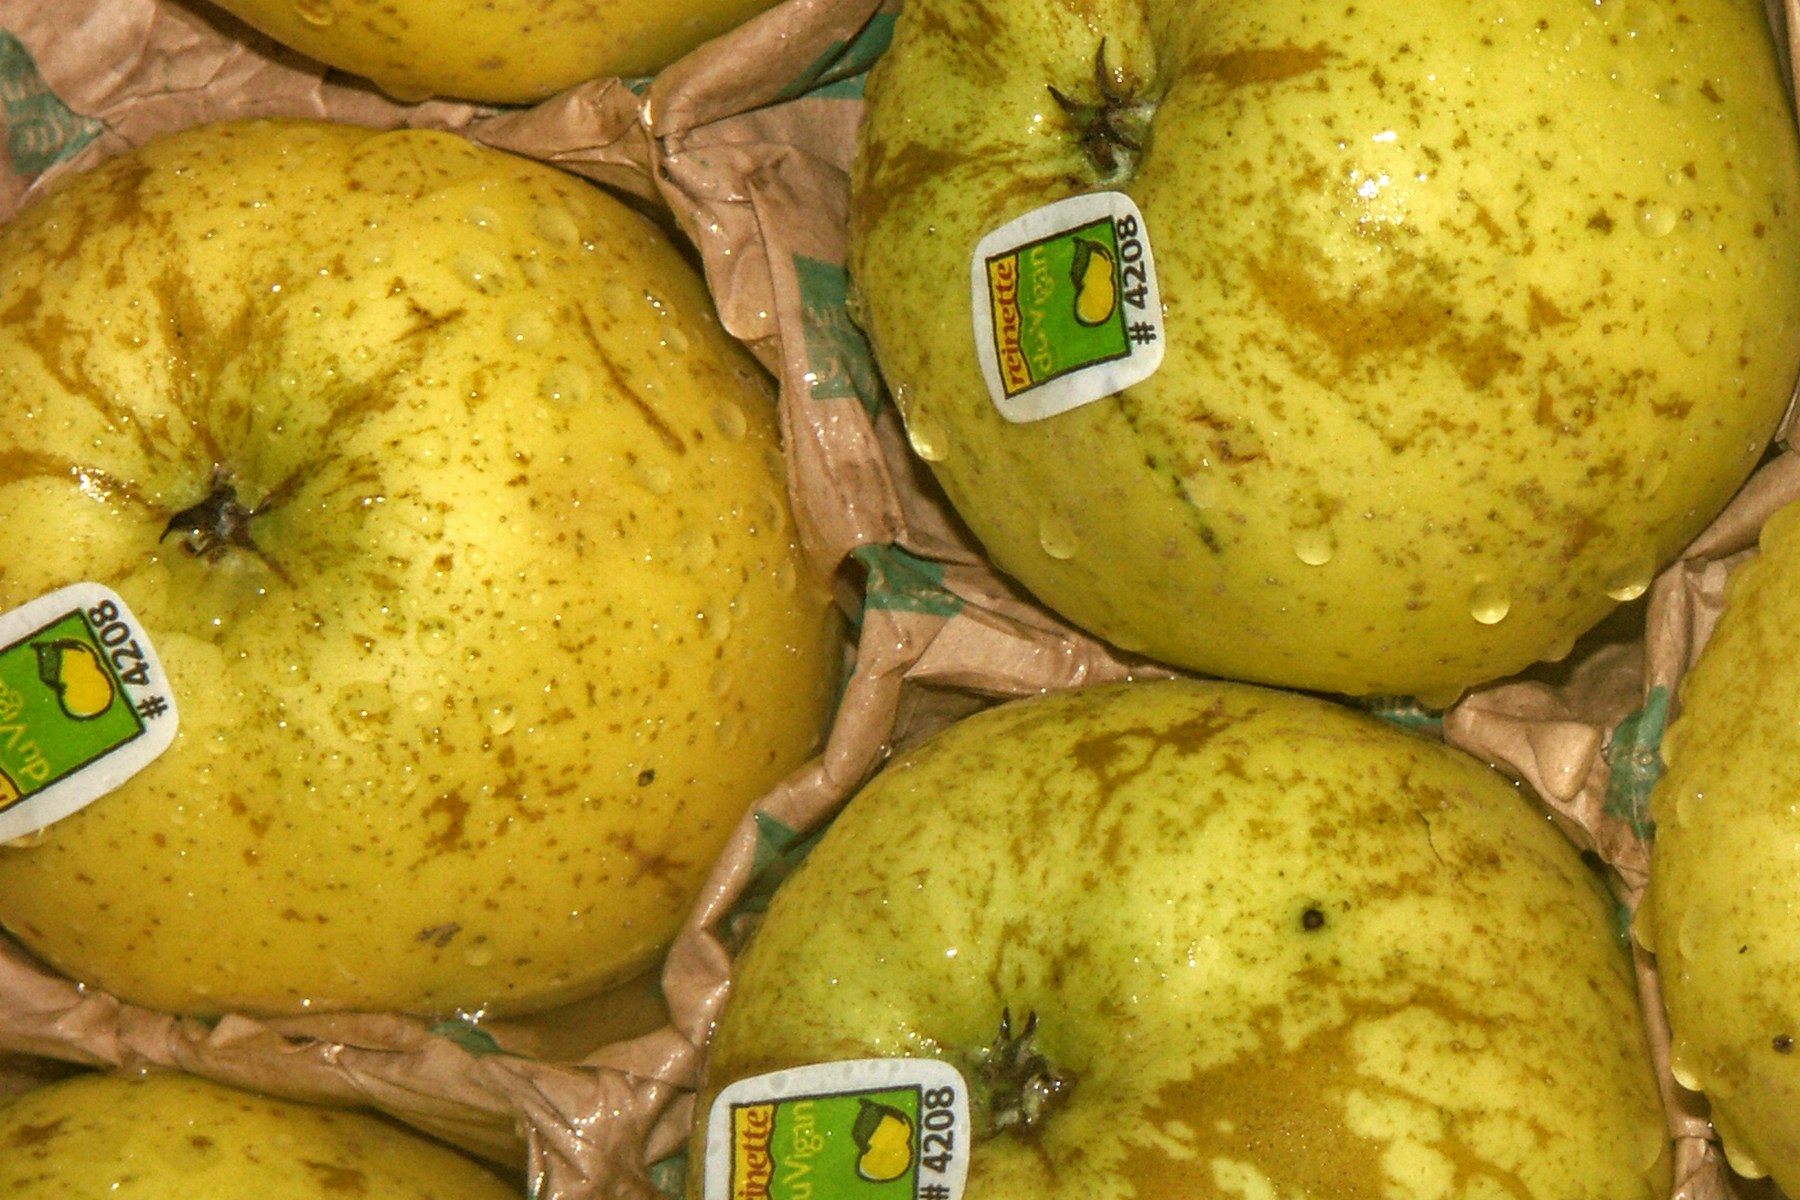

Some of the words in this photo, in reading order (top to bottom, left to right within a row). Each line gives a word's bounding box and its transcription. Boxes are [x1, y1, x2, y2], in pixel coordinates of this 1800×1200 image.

[1117, 213, 1148, 311] 4208
[997, 262, 1025, 387] reinette
[1129, 321, 1158, 346] #
[88, 599, 151, 687] 4208
[136, 695, 169, 720] #
[922, 1085, 956, 1174] 4208
